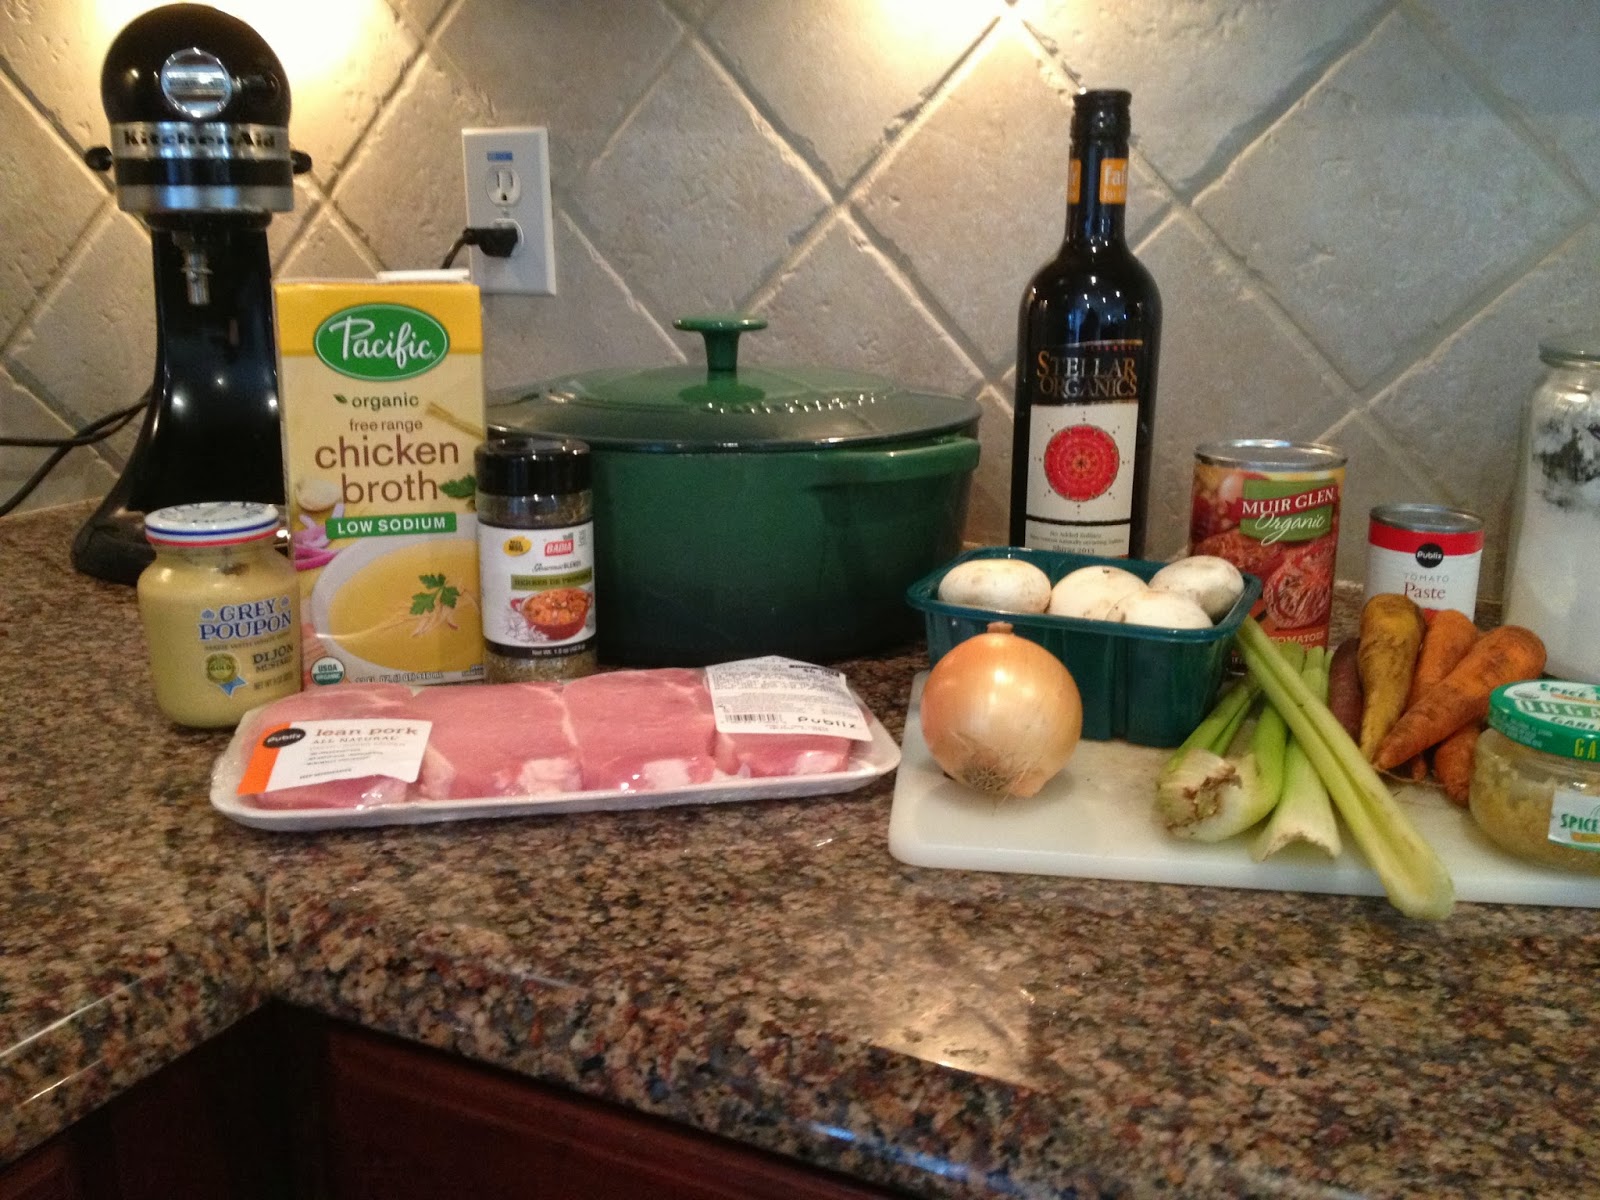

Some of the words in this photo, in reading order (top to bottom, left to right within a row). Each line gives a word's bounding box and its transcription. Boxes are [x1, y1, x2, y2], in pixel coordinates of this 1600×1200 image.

[329, 315, 433, 369] Pacific
[352, 392, 419, 411] organic
[350, 418, 378, 431] free
[381, 419, 423, 433] range
[314, 434, 459, 469] chicken
[342, 471, 438, 504] broth
[1242, 497, 1291, 515] MUIR
[1295, 487, 1334, 509] GLEN
[337, 520, 373, 535] LOW
[378, 517, 446, 531] SODIUM
[1255, 512, 1325, 546] Organic
[1416, 550, 1443, 559] Publix
[1402, 572, 1450, 583] TOMATO
[1404, 582, 1446, 600] Paste
[220, 597, 277, 622] GREY
[200, 610, 292, 640] POUPON
[253, 643, 293, 664] DIJON
[318, 664, 338, 672] USDA
[266, 731, 302, 744] Publix
[317, 728, 362, 737] lean
[368, 727, 418, 736] pork
[1573, 737, 1597, 759] GA
[1560, 813, 1598, 832] SPICE
